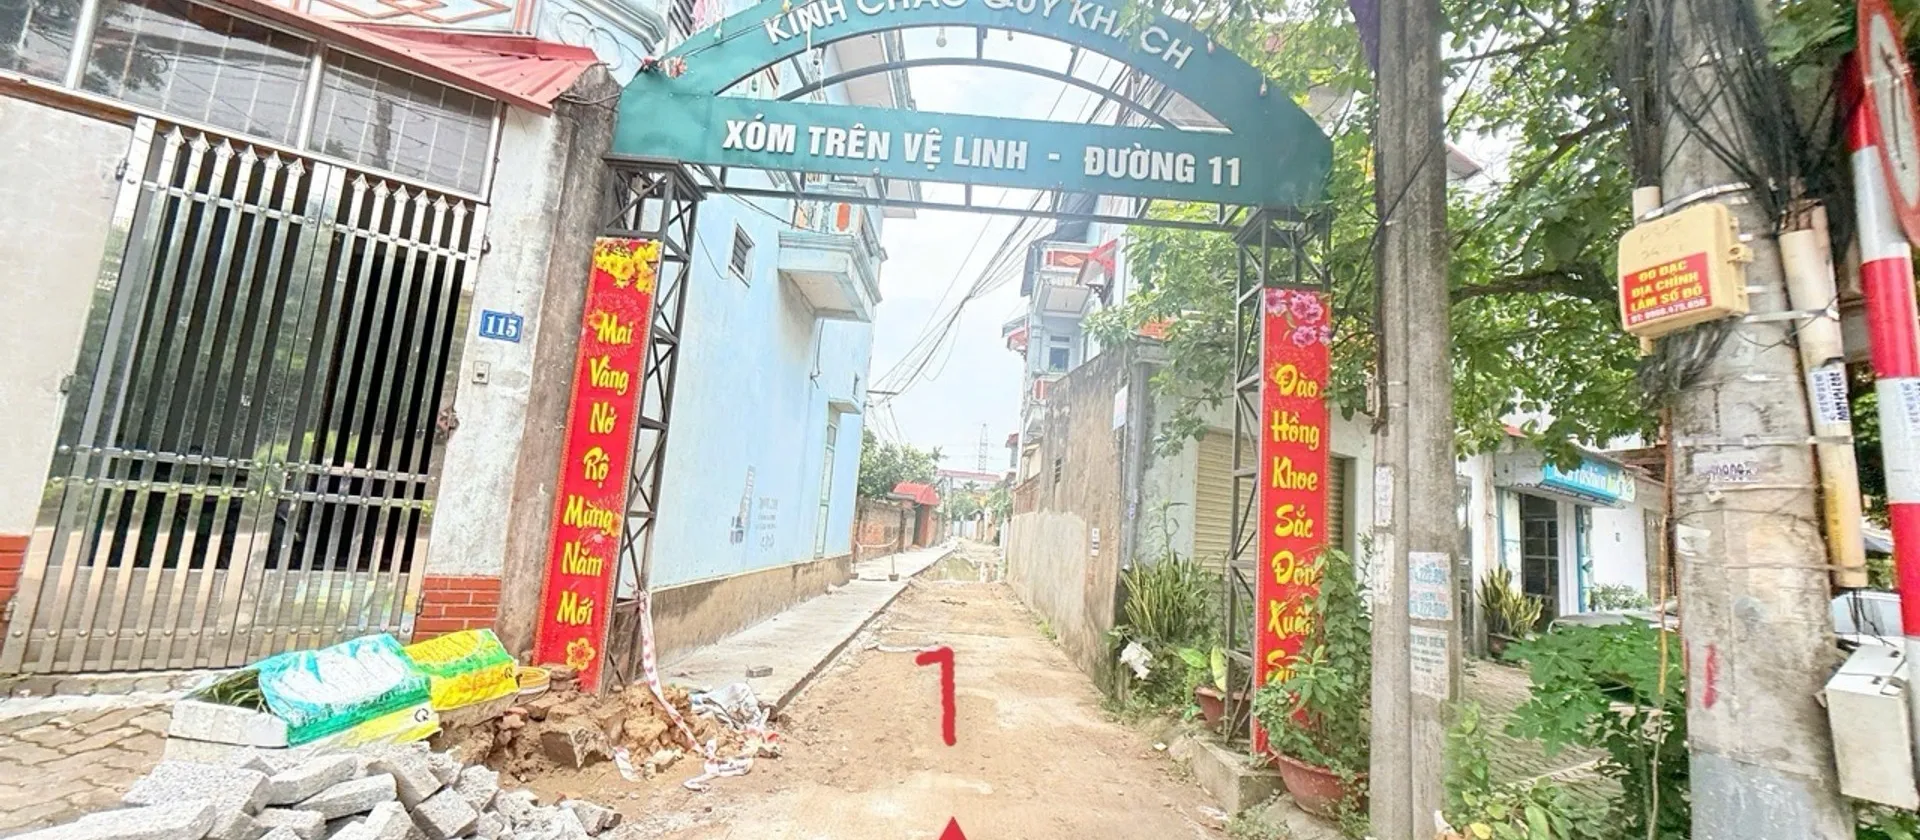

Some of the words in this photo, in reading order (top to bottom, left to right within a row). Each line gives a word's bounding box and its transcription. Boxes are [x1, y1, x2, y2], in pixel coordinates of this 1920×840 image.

[722, 113, 797, 154] XÓM
[808, 122, 890, 161] TRÊN
[904, 127, 943, 171] VỆ
[953, 136, 1027, 171] LINH
[1085, 142, 1195, 184] ĐƯỜNG
[1208, 155, 1240, 186] 11
[486, 315, 517, 338] 115
[597, 312, 634, 346] Mai
[589, 356, 630, 396] Vàng
[1275, 363, 1319, 398] Đào
[589, 402, 618, 435] Nở
[1271, 410, 1320, 451] Hồng
[583, 446, 611, 488] Rộ
[1272, 456, 1318, 491] Khoe
[563, 494, 612, 537] Mừng
[1274, 504, 1314, 539] Sắc
[561, 542, 603, 577] Năm
[1271, 550, 1316, 586] Đón
[556, 591, 594, 626] Mới
